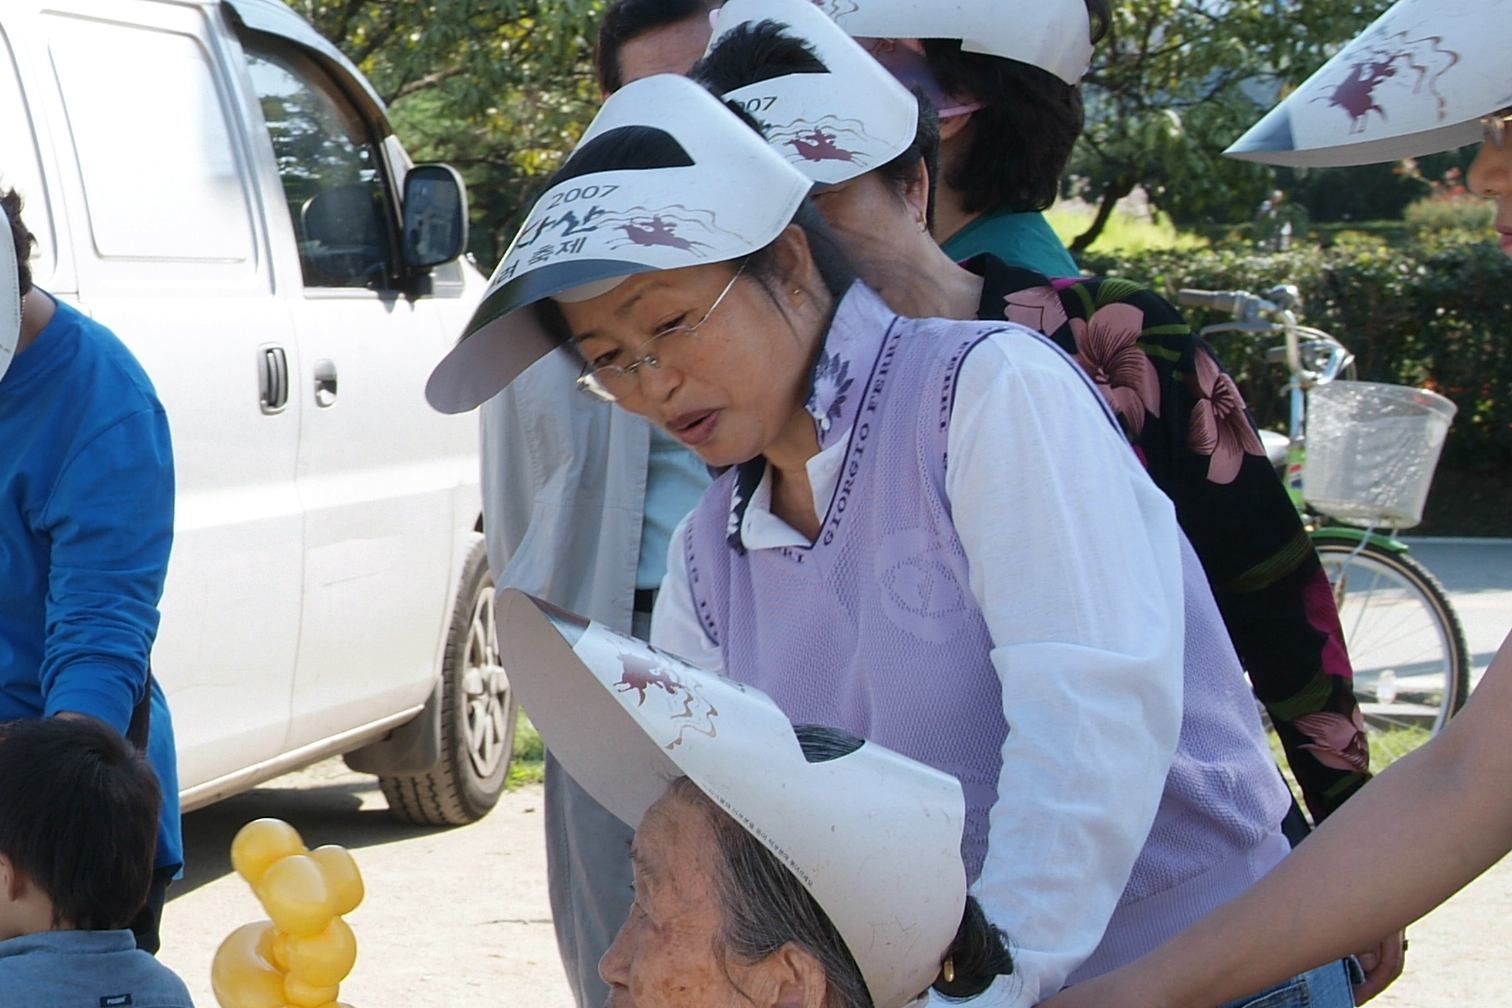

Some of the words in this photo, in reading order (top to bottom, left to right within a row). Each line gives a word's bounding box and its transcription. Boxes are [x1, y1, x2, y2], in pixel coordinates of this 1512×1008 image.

[546, 185, 620, 211] 2007
[527, 236, 588, 266] 축제
[823, 422, 870, 546] GIORGIO
